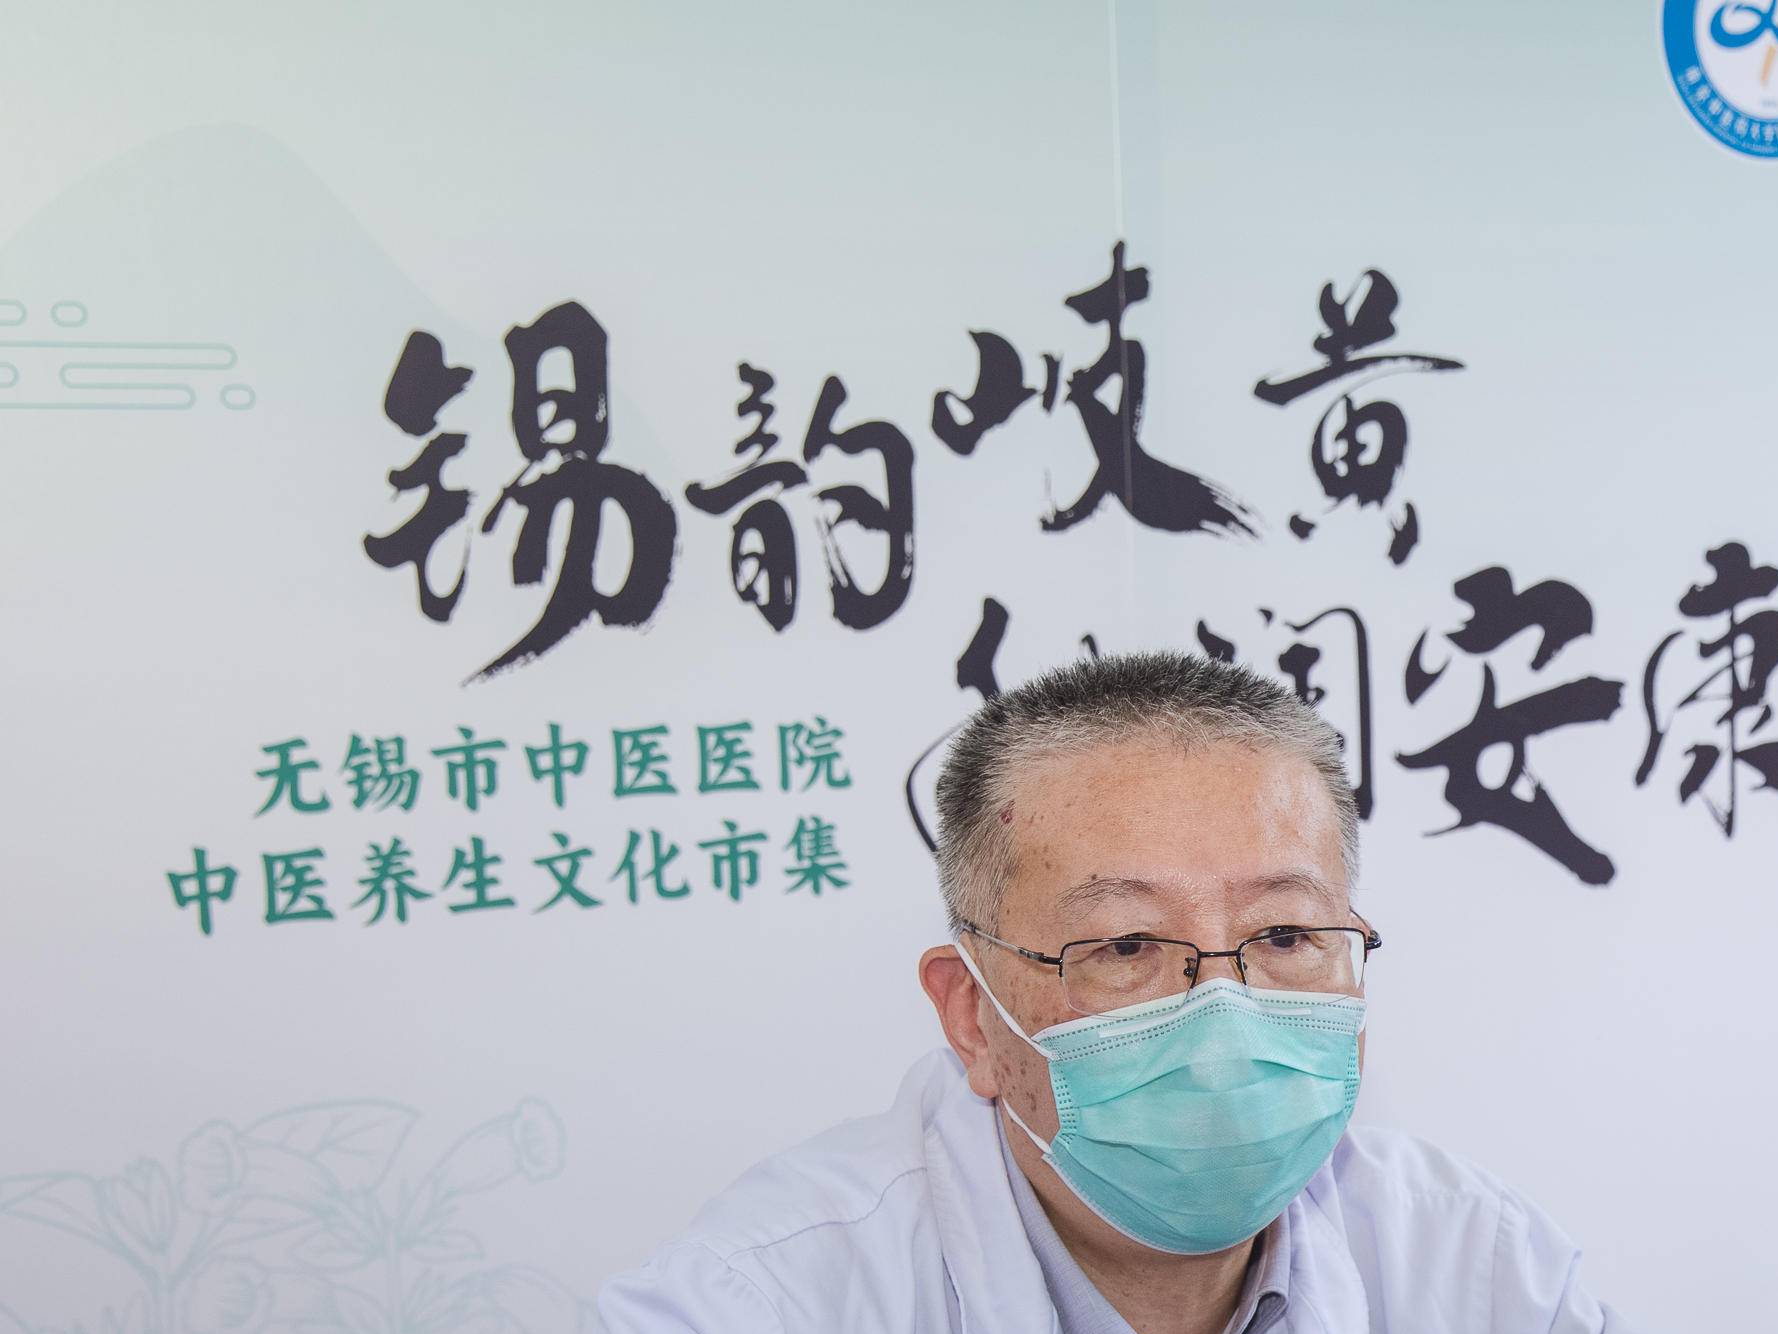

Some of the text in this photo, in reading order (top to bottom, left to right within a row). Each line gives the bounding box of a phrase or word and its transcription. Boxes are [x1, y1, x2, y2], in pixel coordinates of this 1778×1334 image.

[252, 714, 854, 820] 无锡市中医医院
[166, 815, 852, 936] 中医养生文化市集
